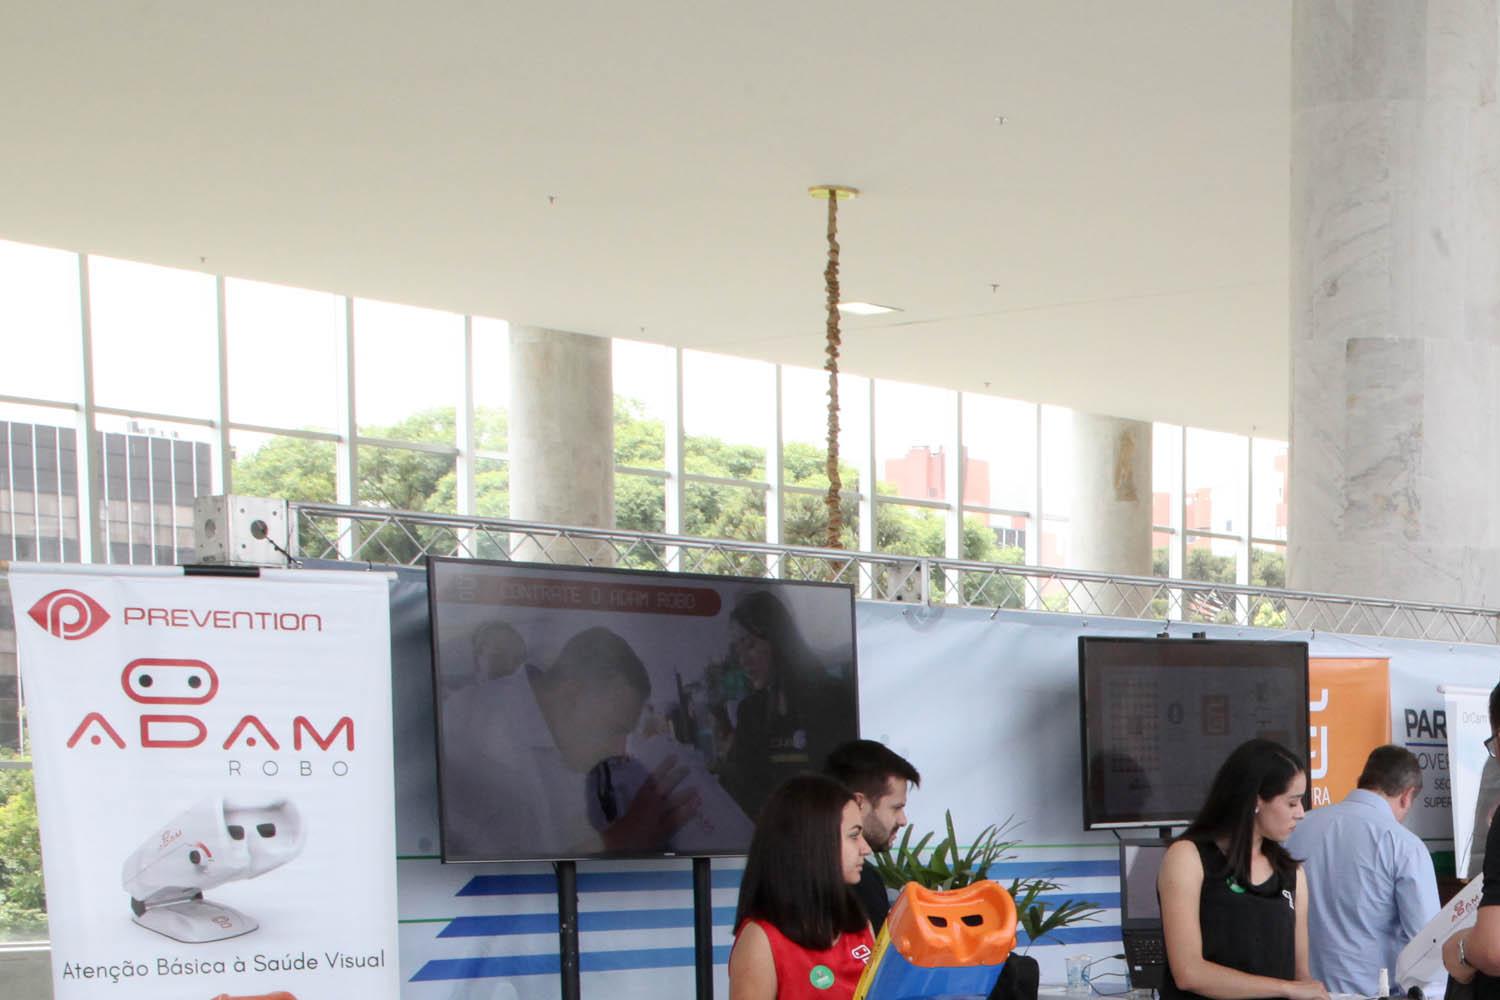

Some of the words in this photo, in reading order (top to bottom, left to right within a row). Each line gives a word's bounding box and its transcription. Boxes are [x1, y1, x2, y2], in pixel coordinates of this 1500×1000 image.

[123, 606, 323, 632] PREVENTION
[66, 711, 356, 752] ADAM
[228, 760, 349, 777] ROBO
[62, 958, 149, 984] Atenção
[157, 955, 226, 977] Básica
[232, 954, 247, 974] à
[253, 950, 319, 972] Saúde
[325, 949, 386, 970] Visual
